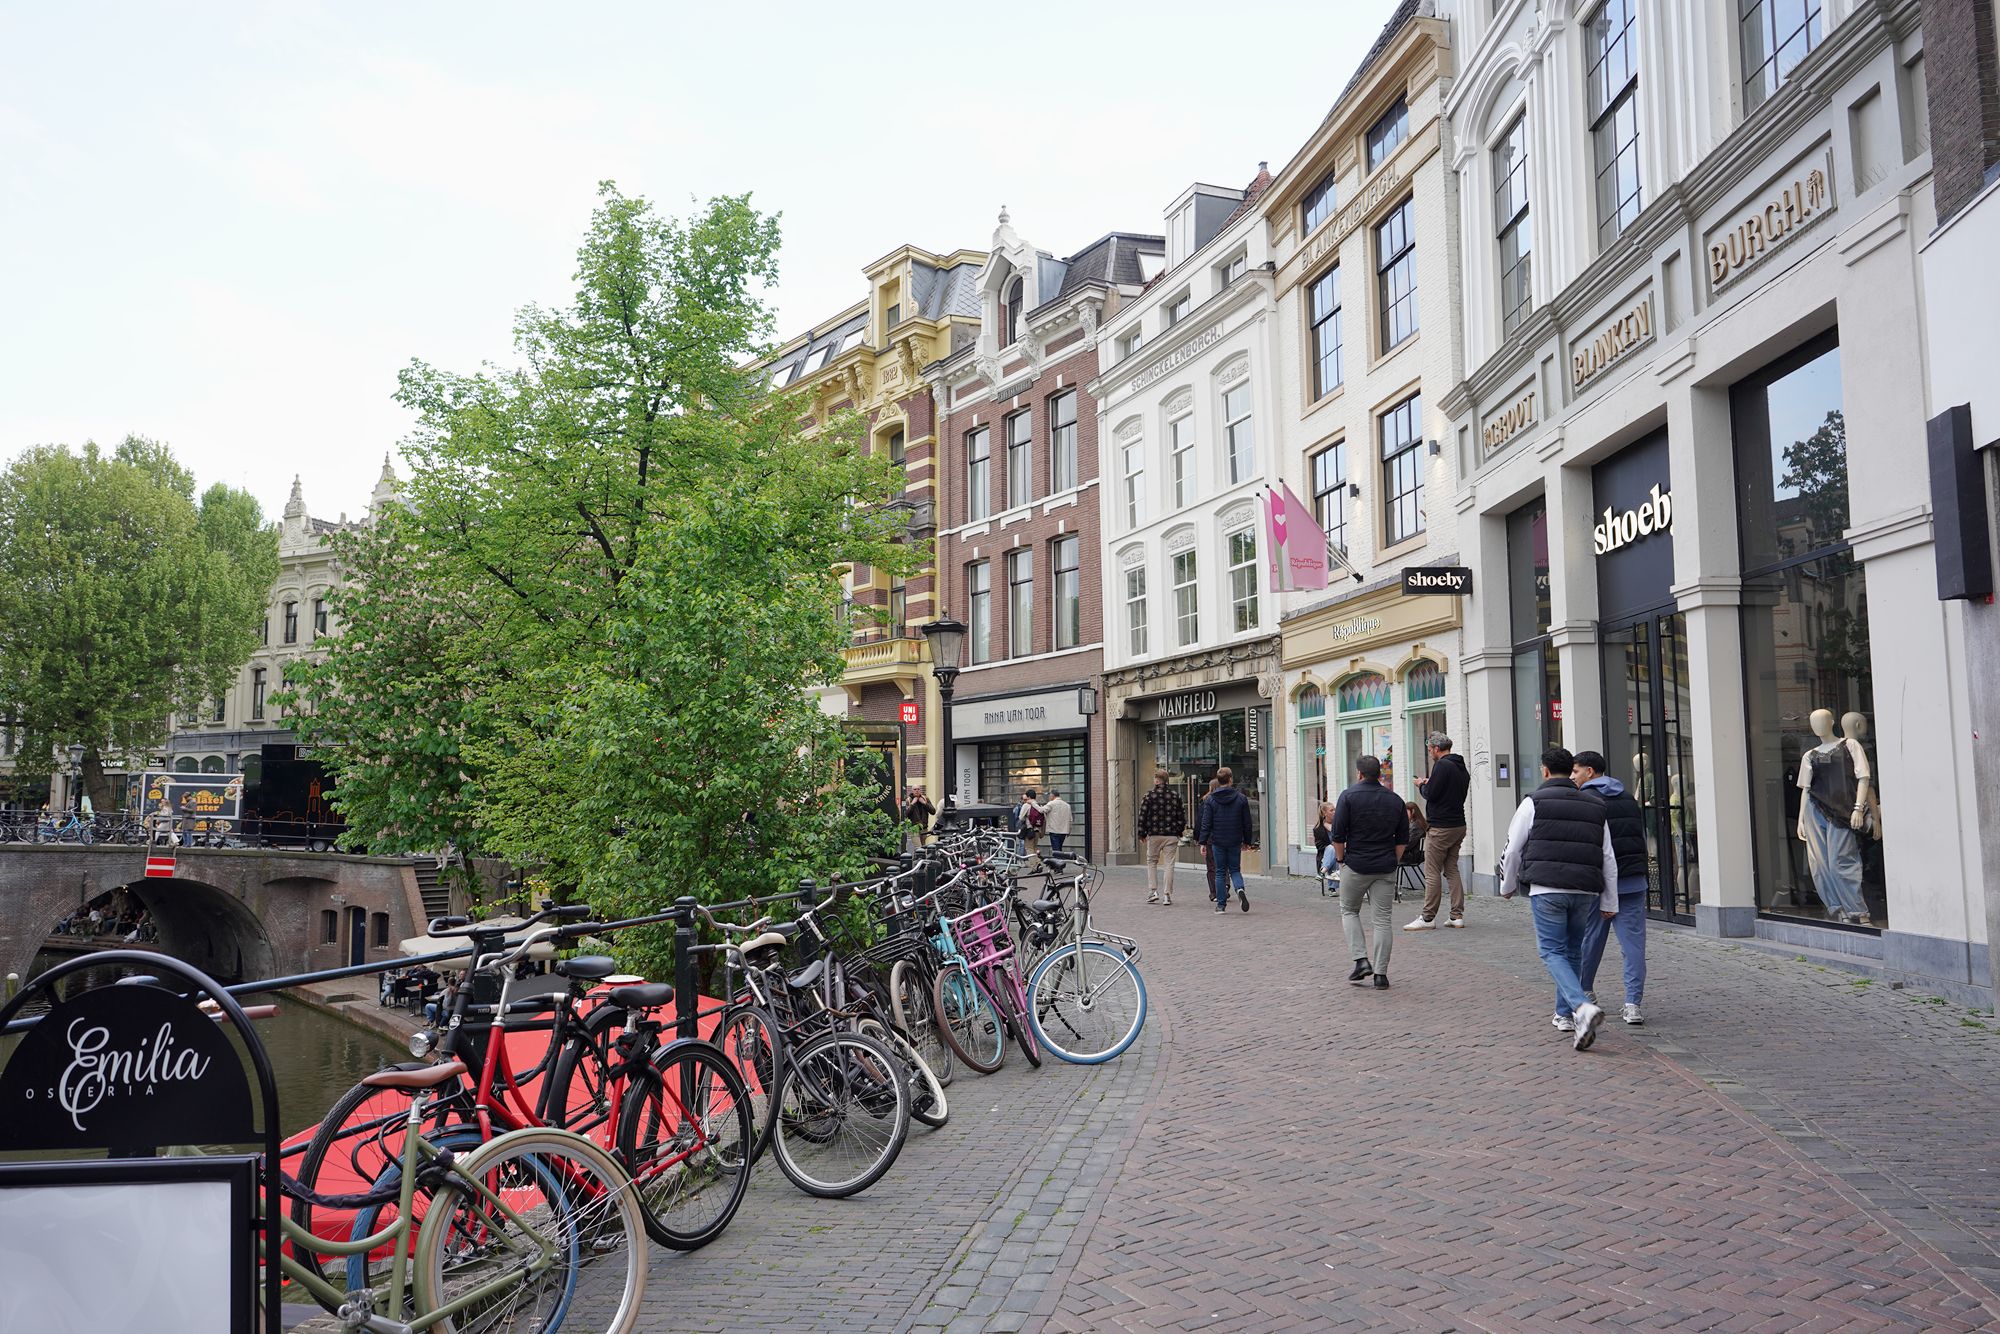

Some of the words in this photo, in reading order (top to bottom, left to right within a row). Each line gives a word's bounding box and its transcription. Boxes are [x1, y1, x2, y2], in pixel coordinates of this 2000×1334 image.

[1302, 163, 1400, 270] BLANKENBURGH.
[1490, 392, 1535, 447] GROOT
[1573, 301, 1649, 386] BLANKEN
[1708, 180, 1811, 285] BURGH.
[1131, 326, 1220, 391] SCHINCKELENBORCH.
[882, 366, 898, 385] 1882
[1594, 483, 1673, 554] shoeb
[1408, 572, 1466, 589] shoeby
[1333, 616, 1381, 641] République
[984, 711, 1004, 722] ANNA
[1007, 709, 1023, 720] VAN
[1025, 707, 1046, 719] TOOR
[1158, 691, 1216, 717] MANFIELD
[903, 714, 917, 722] QLO
[58, 1017, 211, 1131] Emilia
[26, 1084, 154, 1099] OSTERIA
